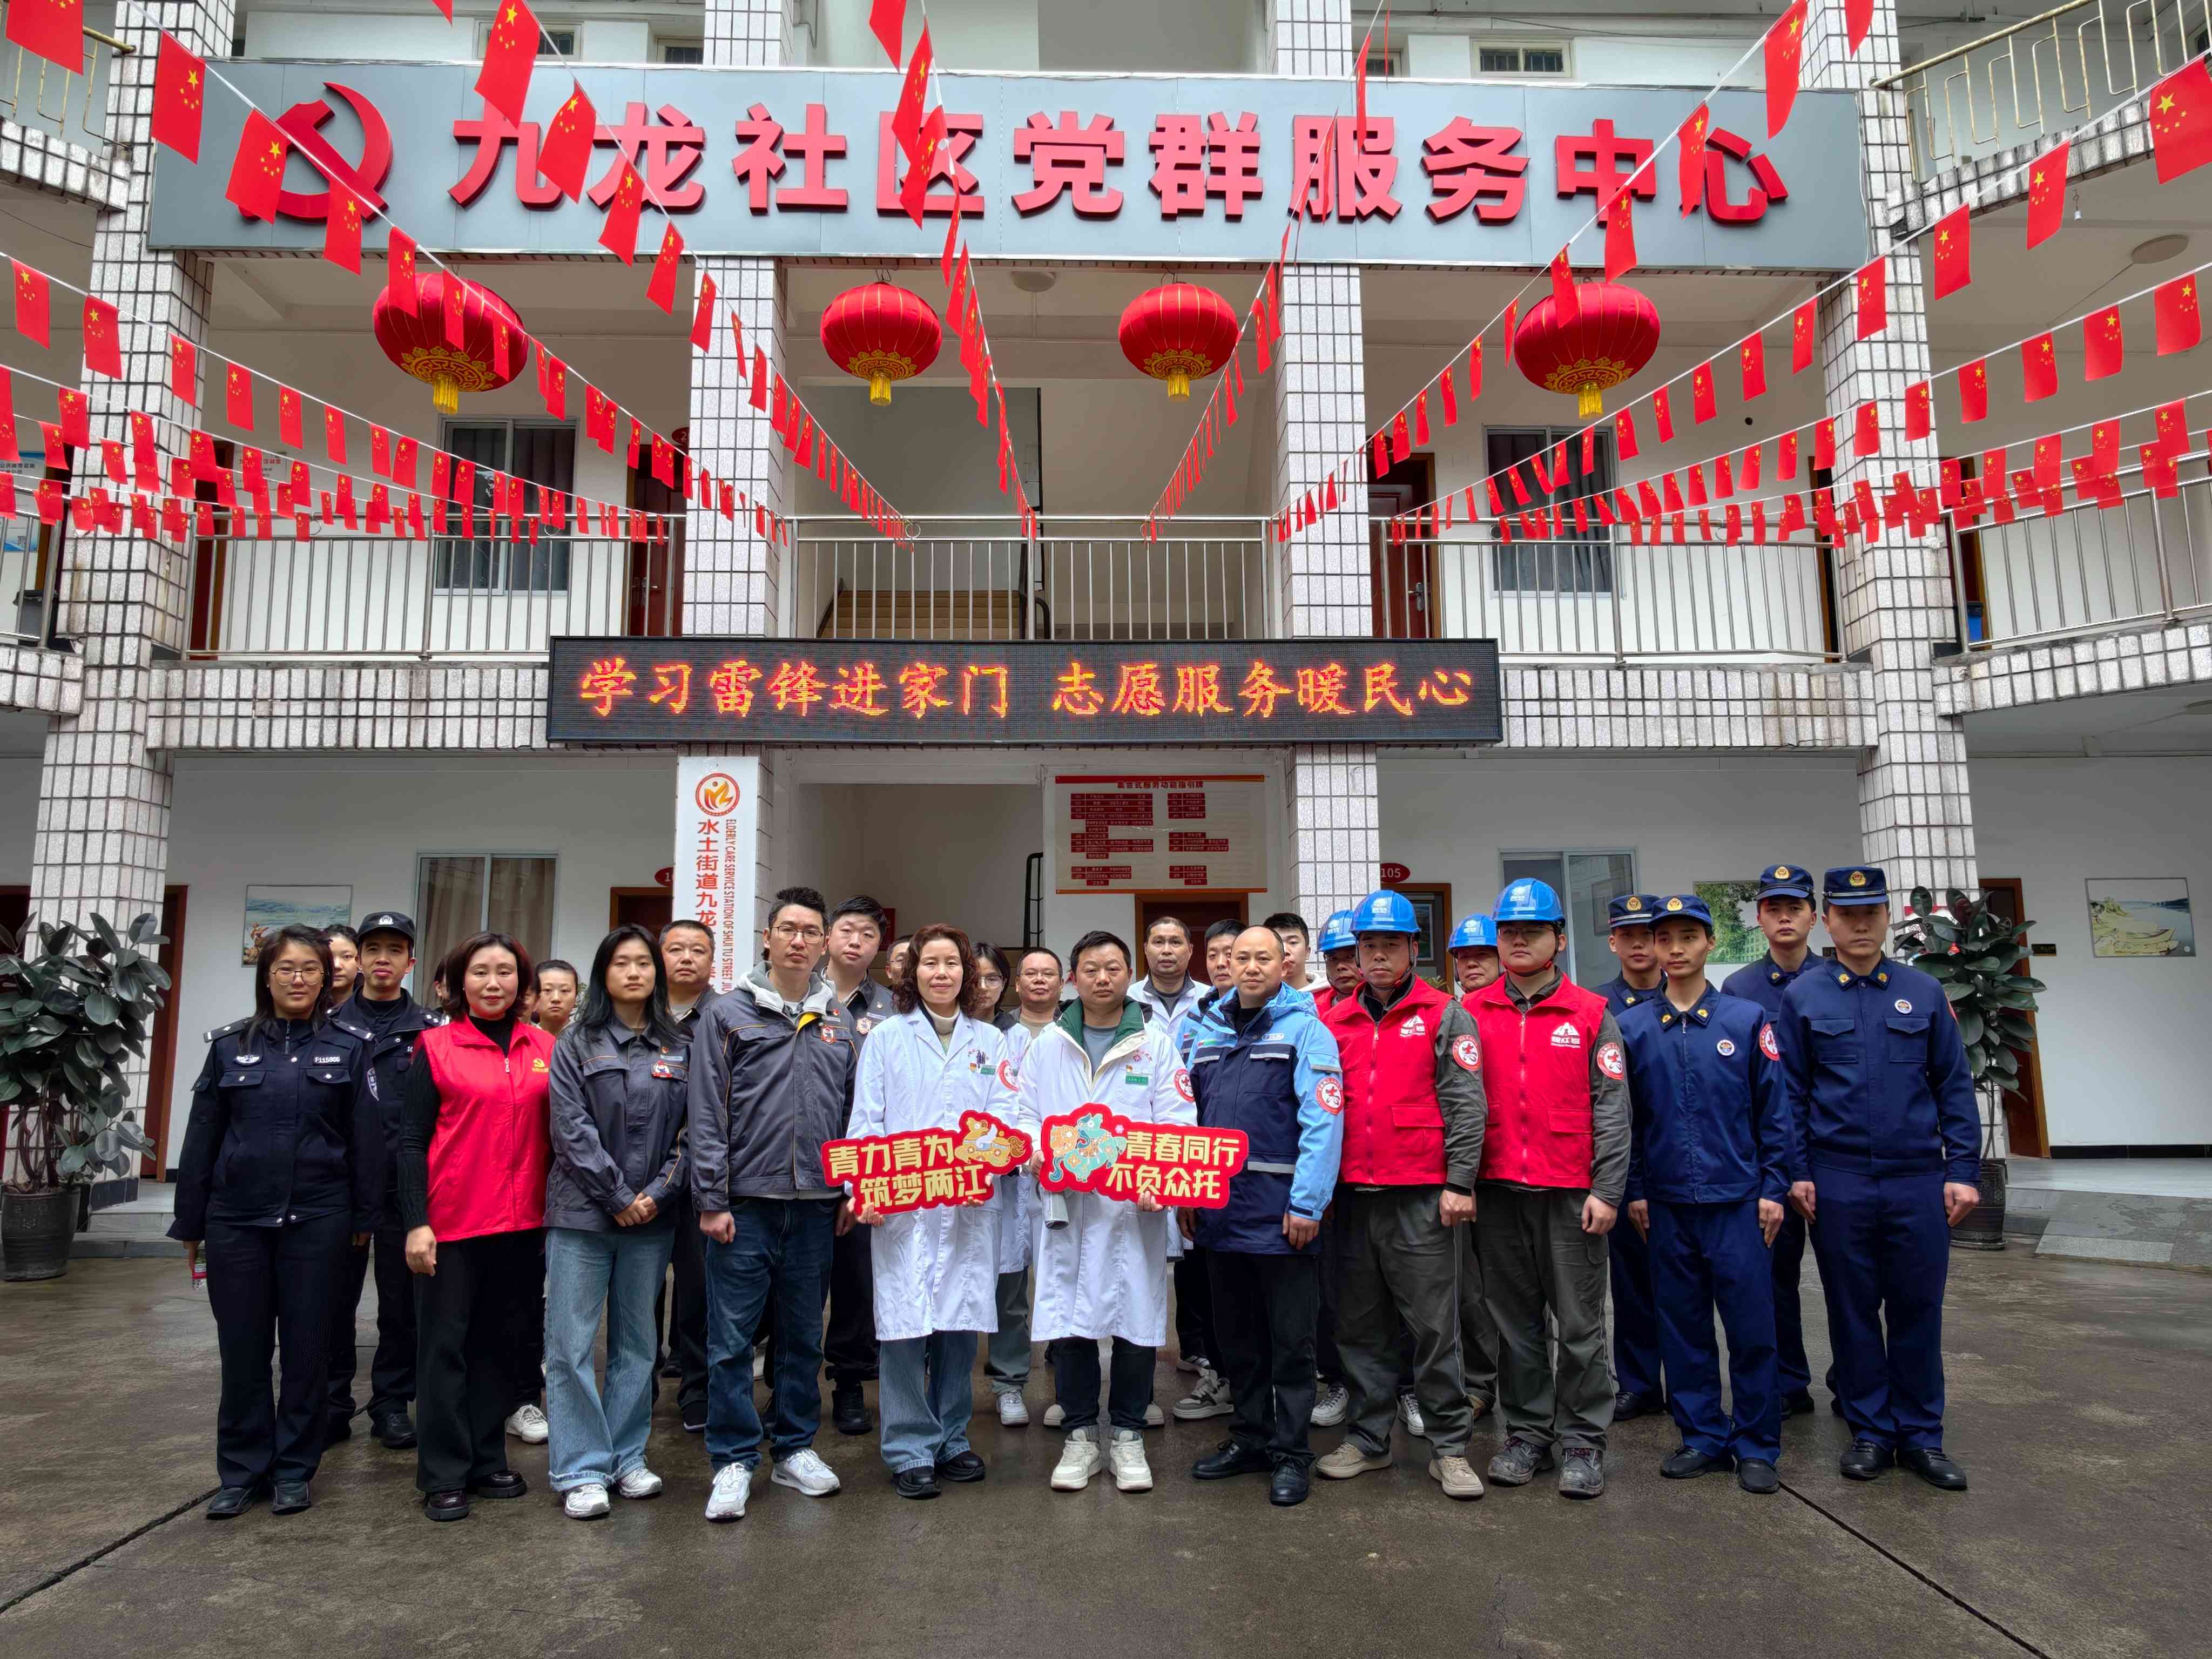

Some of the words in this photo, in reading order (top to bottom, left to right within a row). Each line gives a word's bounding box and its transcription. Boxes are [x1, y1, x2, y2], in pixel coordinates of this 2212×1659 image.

[448, 100, 1789, 225] 九龙社区党群服务中心
[581, 658, 1008, 719] 学习雷锋进家门
[1052, 662, 1471, 718] 志愿服务暖民心
[726, 819, 737, 845] ELDERLY
[725, 846, 736, 862] CARE
[724, 864, 735, 890] SERVICE
[1381, 868, 1401, 878] 105
[723, 891, 734, 919] STATION
[723, 920, 734, 929] OF
[723, 930, 734, 946] SHUI
[723, 948, 733, 957] TU
[722, 958, 733, 980] STREET
[829, 1135, 954, 1178] 青力青为
[1126, 1131, 1240, 1167] 青春同行
[860, 1164, 988, 1208] 筑梦两江
[1105, 1163, 1221, 1199] 不负众托
